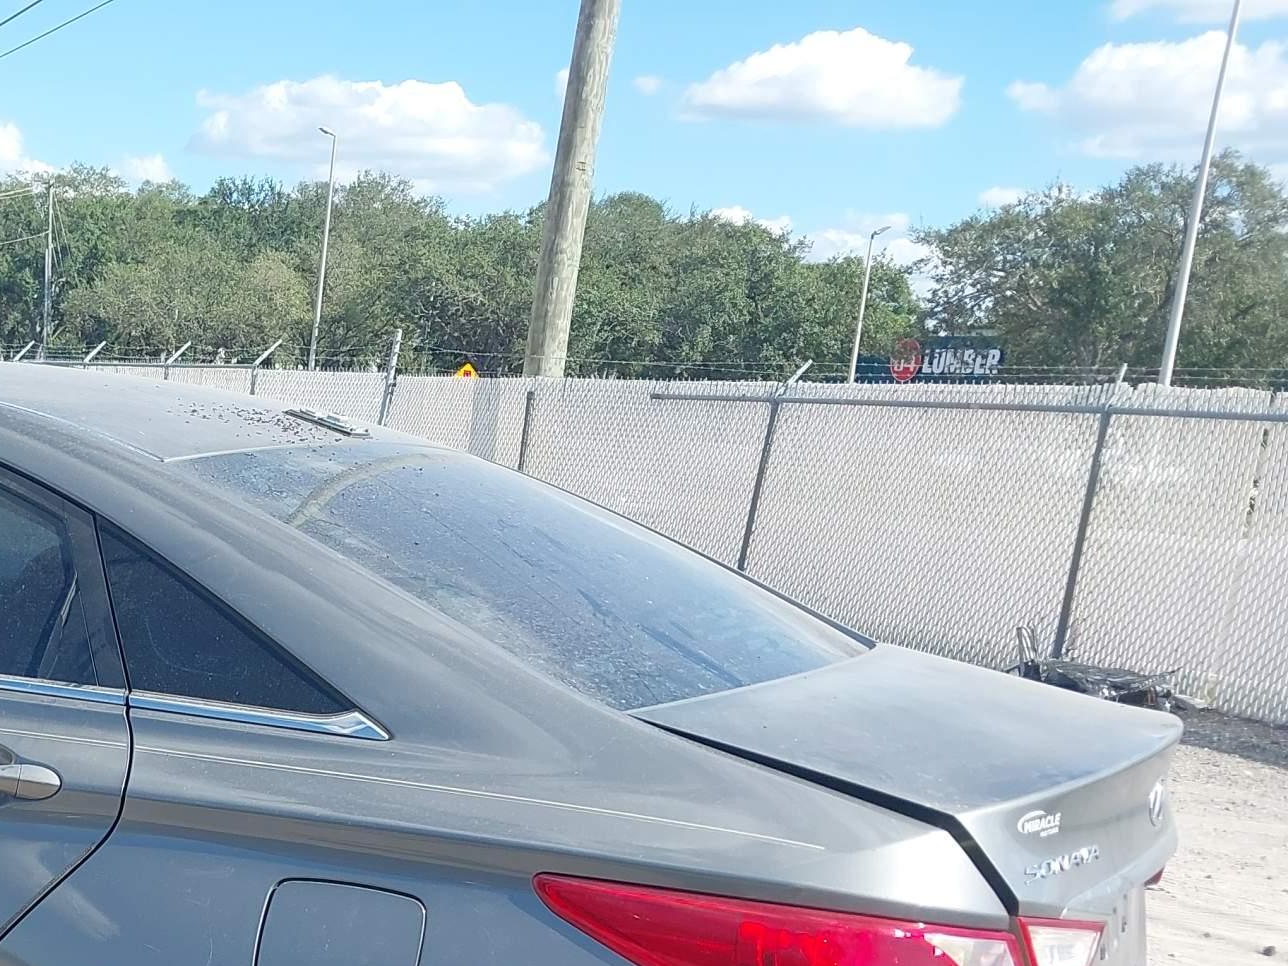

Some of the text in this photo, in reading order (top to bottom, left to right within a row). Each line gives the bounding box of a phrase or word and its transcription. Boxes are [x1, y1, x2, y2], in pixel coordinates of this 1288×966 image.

[921, 348, 1001, 374] LUMBER
[1023, 812, 1062, 834] MIRACLE
[1024, 844, 1100, 885] SONATA
